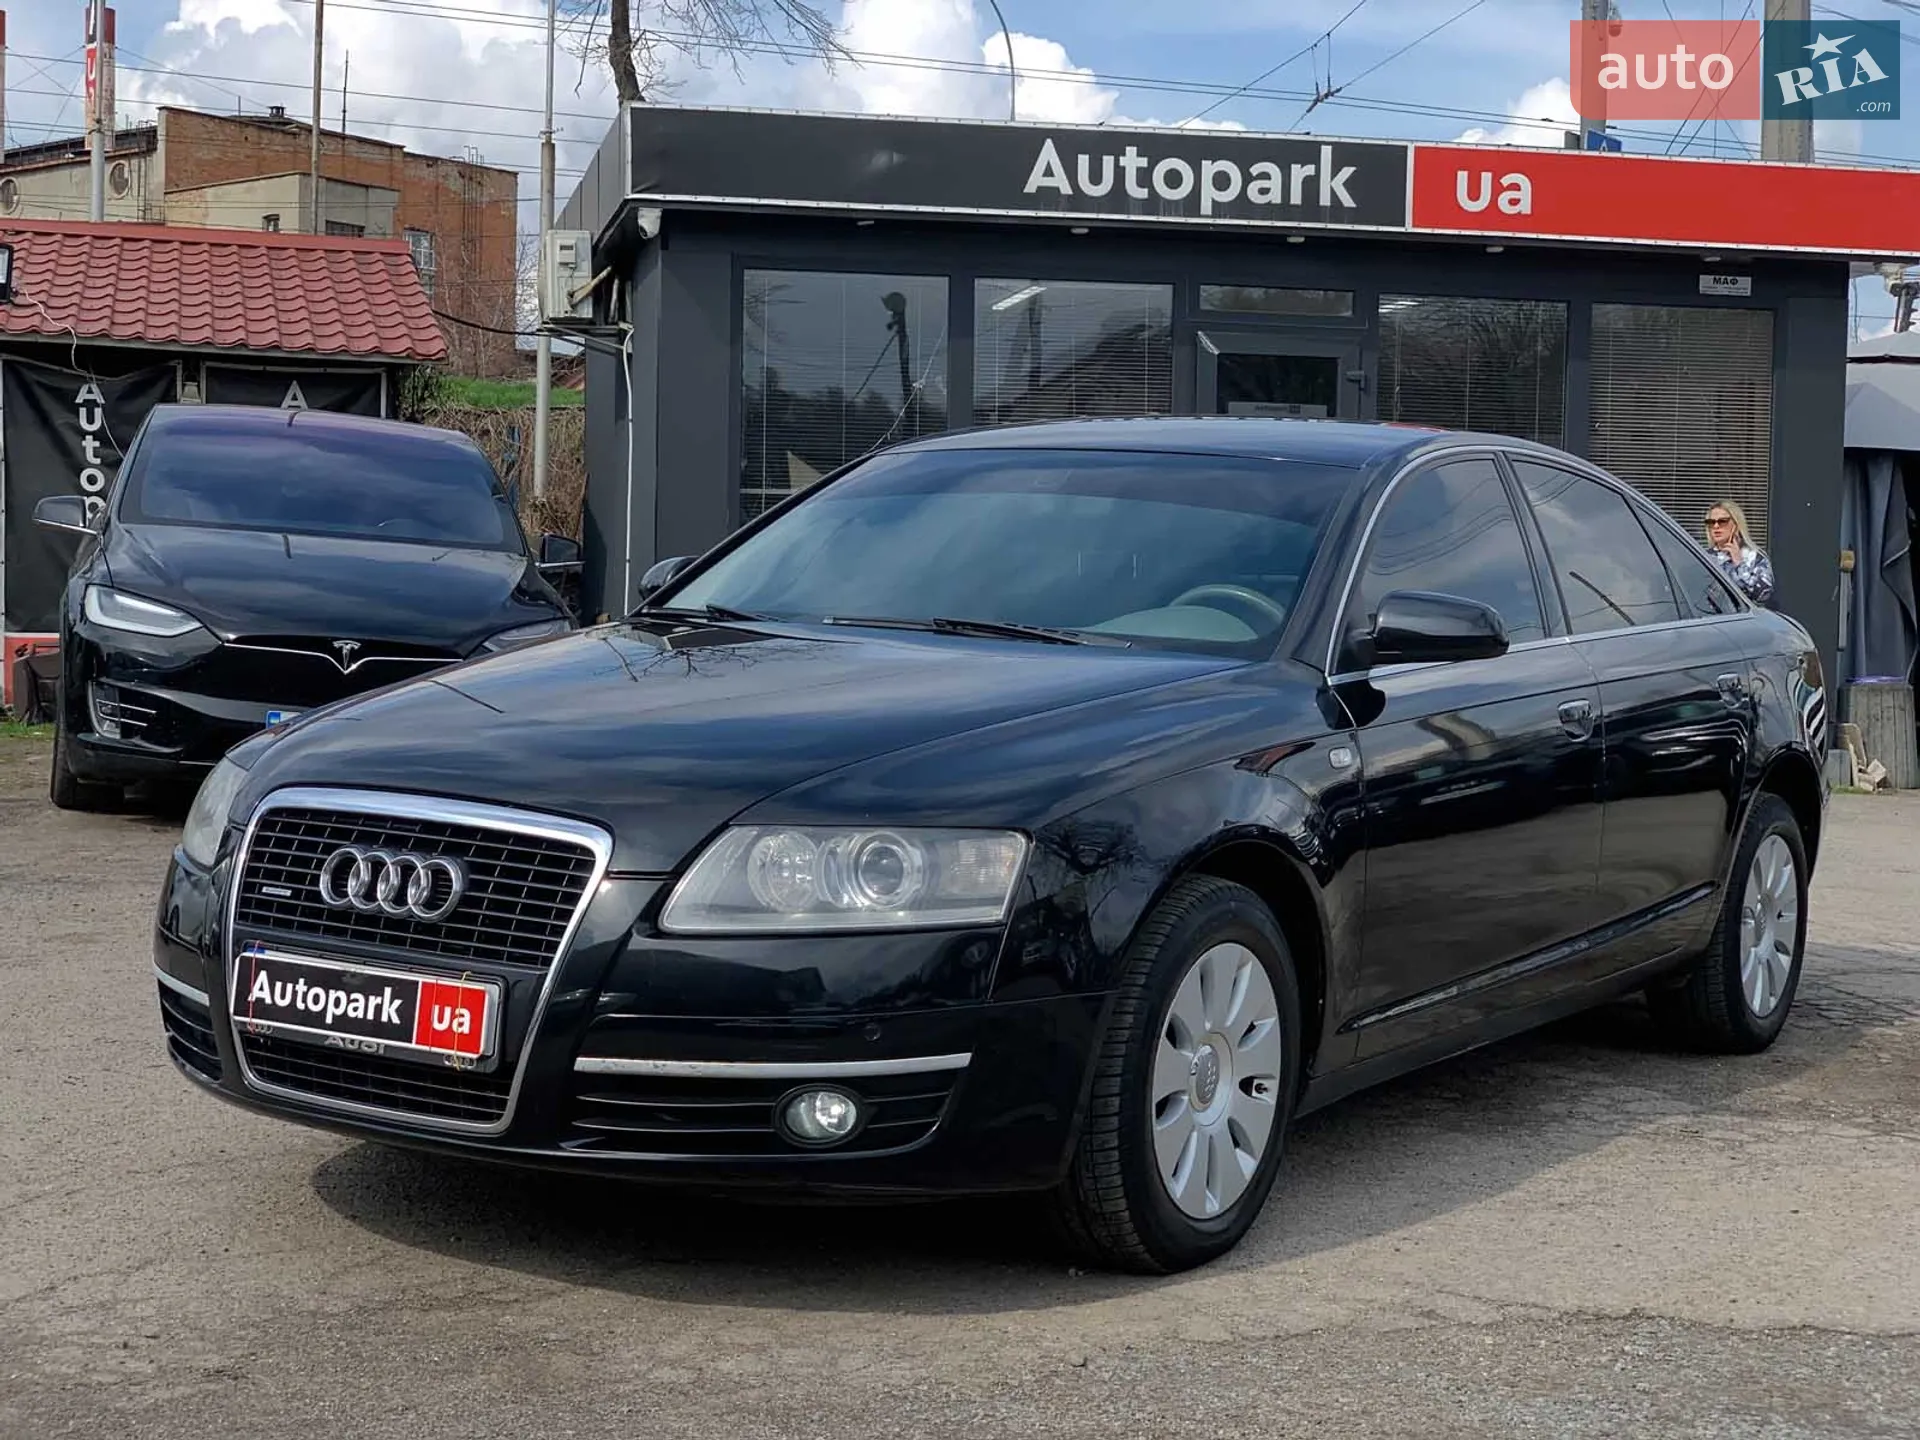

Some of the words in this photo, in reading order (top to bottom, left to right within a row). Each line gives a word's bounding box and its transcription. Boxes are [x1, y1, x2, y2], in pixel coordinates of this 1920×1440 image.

[1023, 138, 1357, 217] Autopark
[1455, 168, 1533, 215] ua
[248, 970, 404, 1024] Autopark
[432, 1003, 471, 1035] ua
